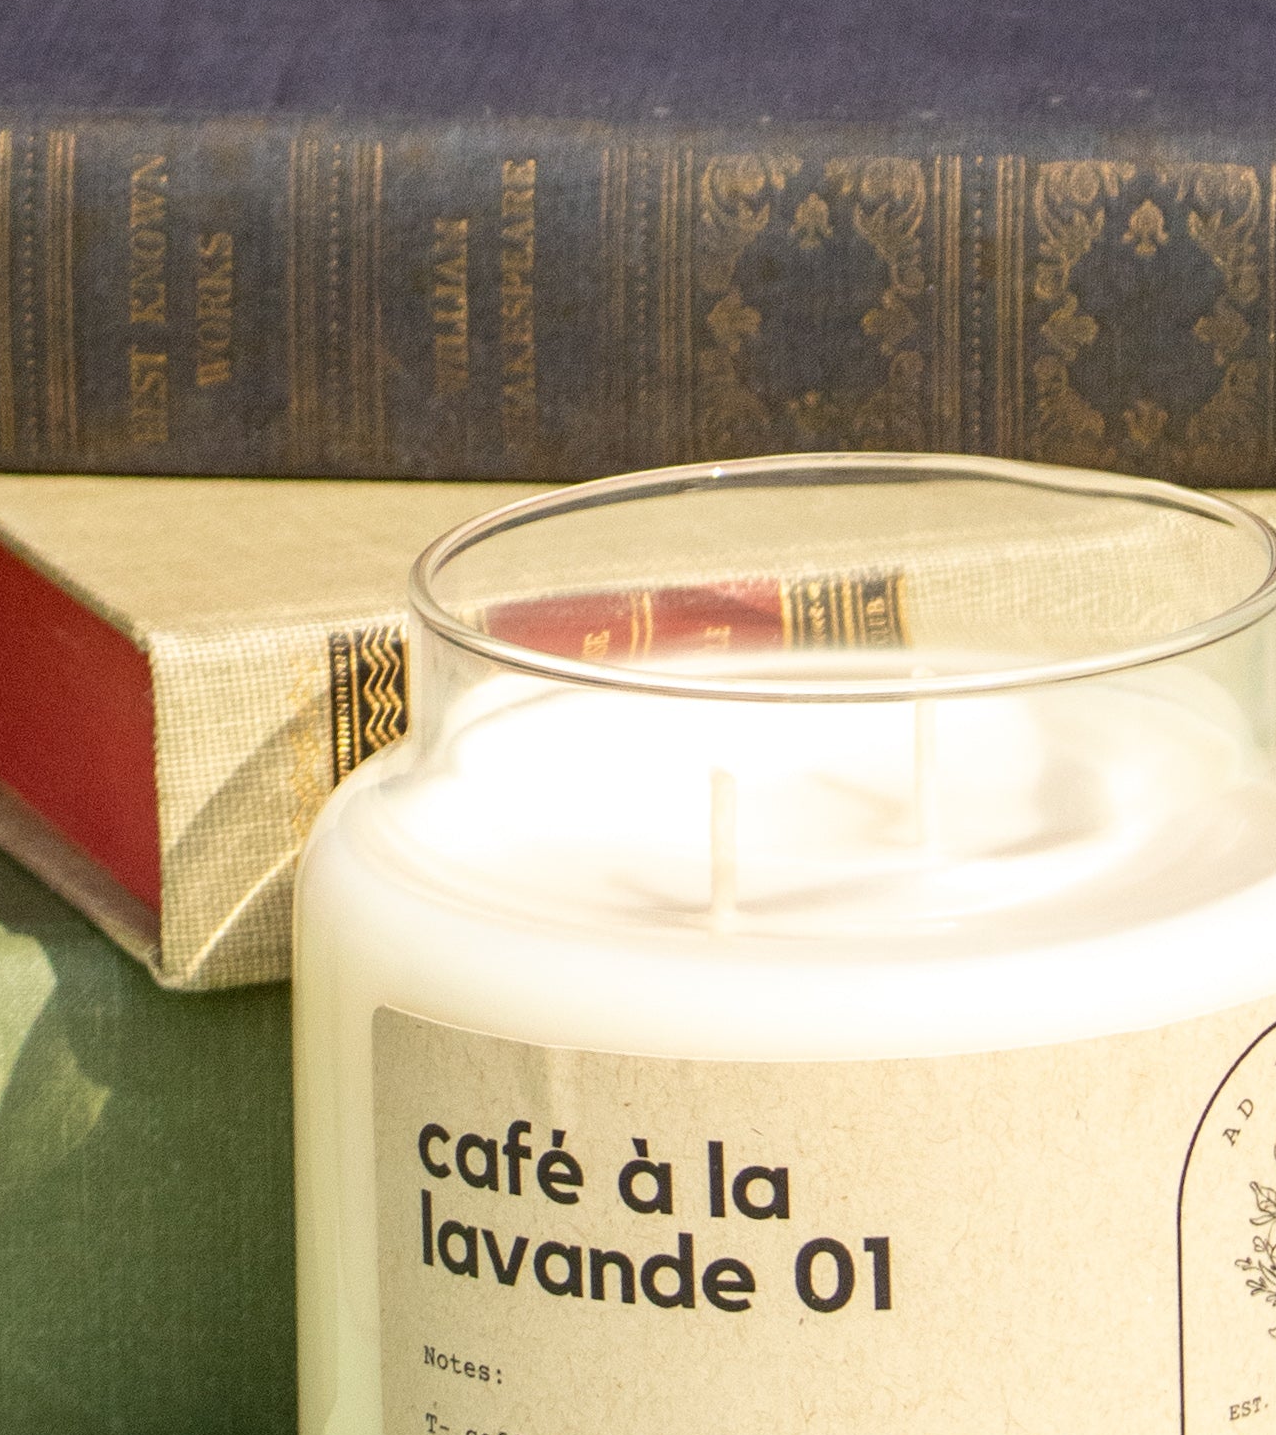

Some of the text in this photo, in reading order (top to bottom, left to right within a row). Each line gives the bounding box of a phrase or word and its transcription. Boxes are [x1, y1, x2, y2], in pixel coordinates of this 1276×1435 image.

[130, 152, 168, 444] BEST KNOWN
[196, 232, 234, 387] WORKS
[434, 217, 469, 394] WILLIAM
[501, 158, 537, 451] AKESPEARE
[418, 1119, 791, 1221] café à la
[1222, 1098, 1255, 1147] AD
[420, 1188, 893, 1314] lavande 01
[423, 1344, 504, 1386] Notes:
[1228, 1395, 1269, 1422] EST.
[425, 1411, 451, 1435] T-
